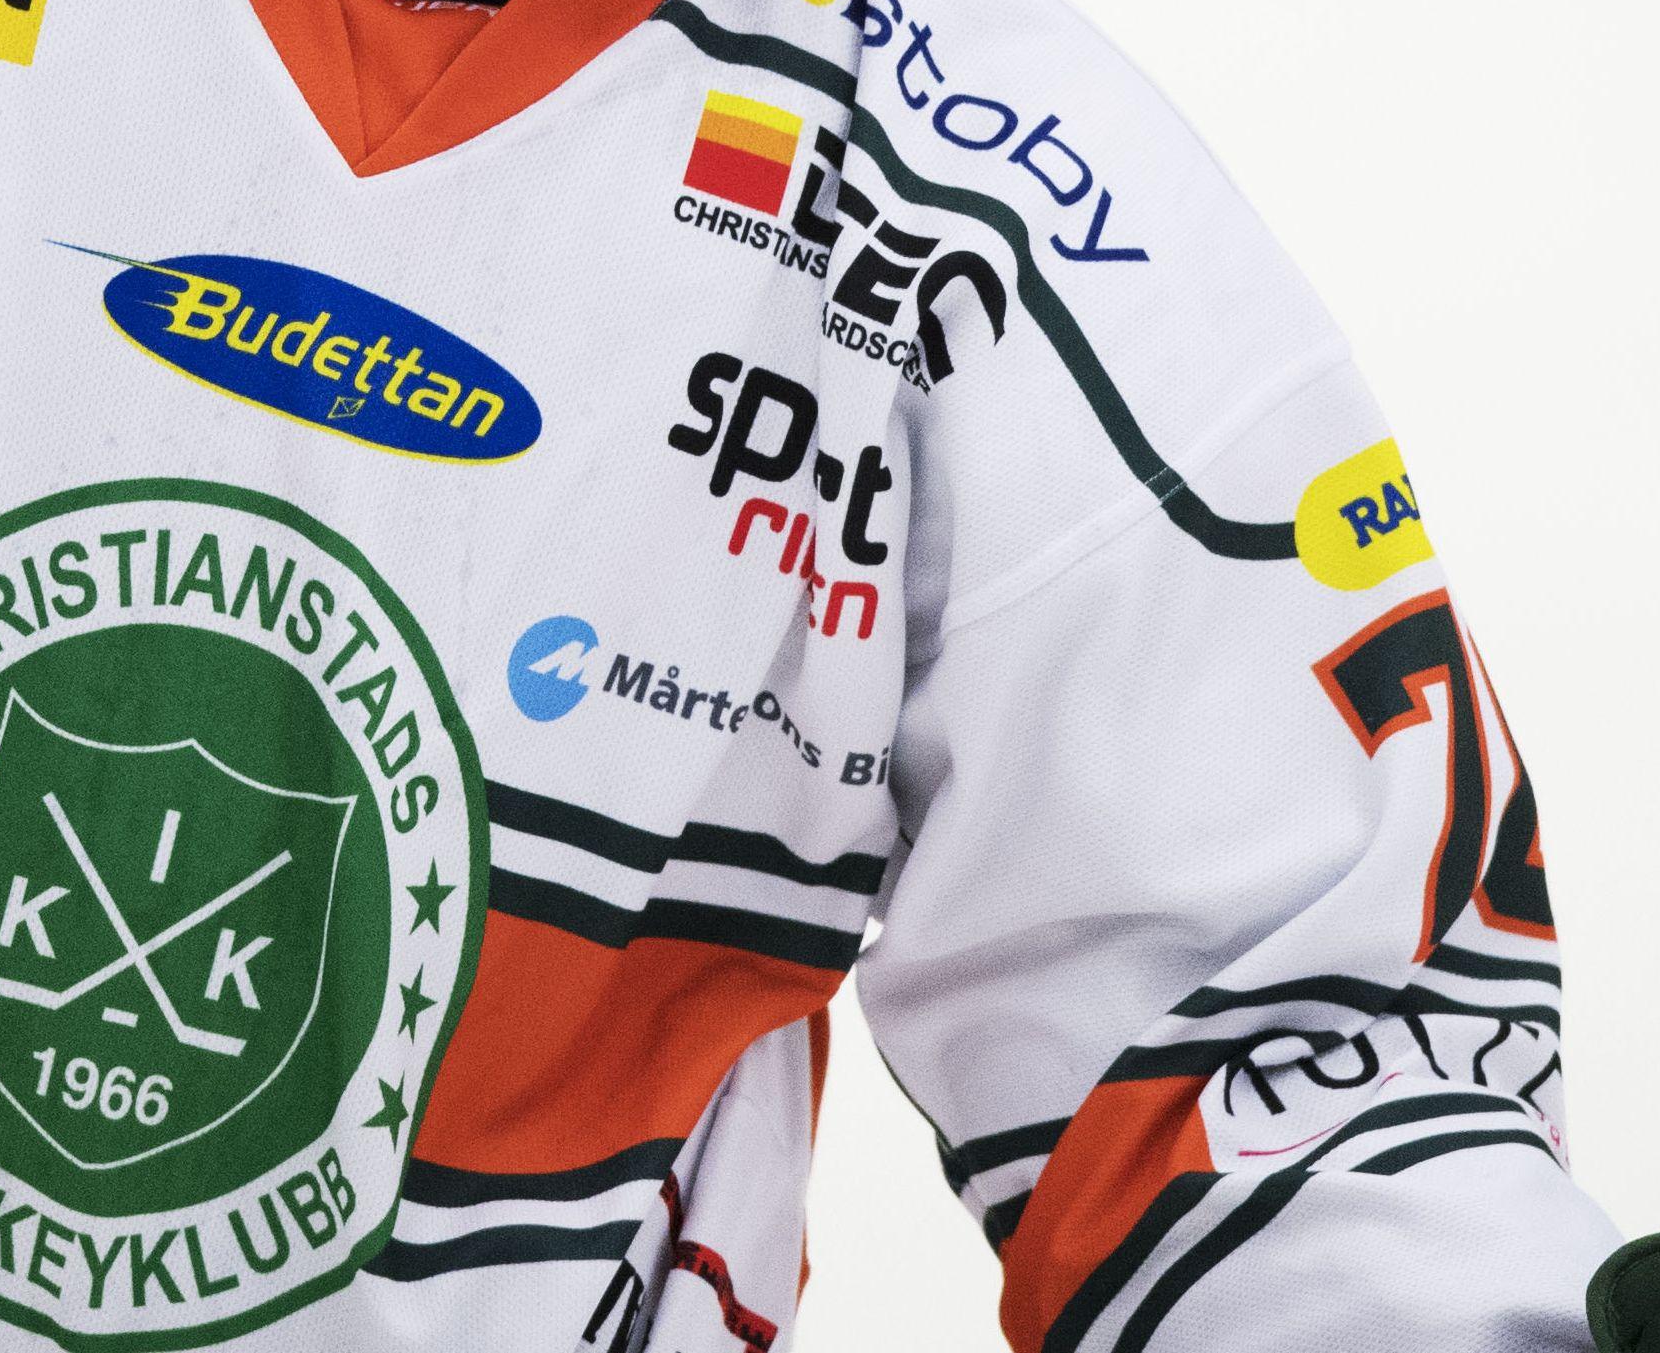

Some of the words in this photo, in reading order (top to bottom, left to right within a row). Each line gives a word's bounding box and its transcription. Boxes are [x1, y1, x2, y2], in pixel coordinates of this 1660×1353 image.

[156, 272, 506, 438] Budettan
[150, 809, 181, 883] I
[203, 929, 275, 1011] K
[32, 1047, 174, 1126] 1966
